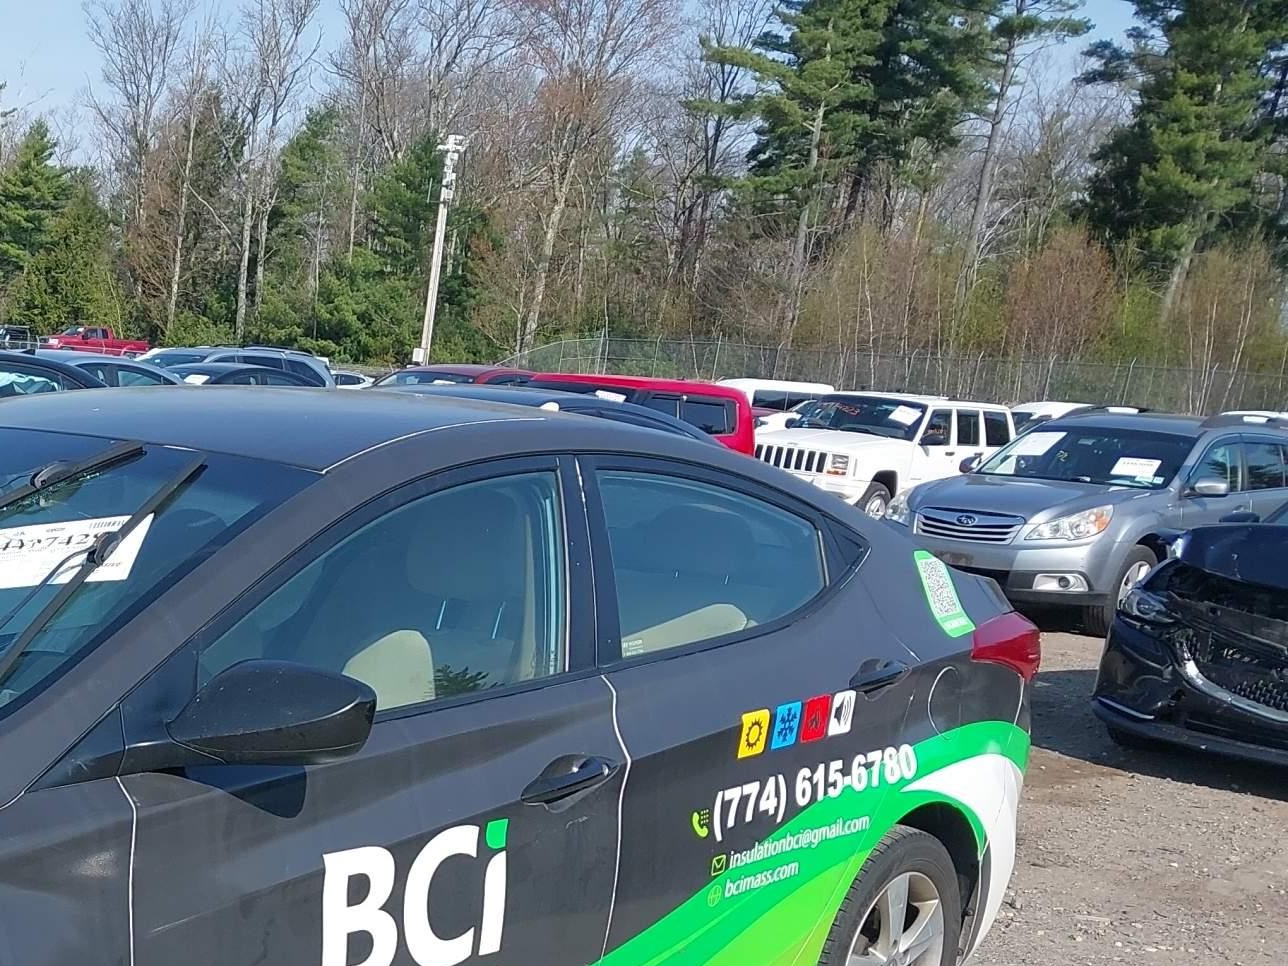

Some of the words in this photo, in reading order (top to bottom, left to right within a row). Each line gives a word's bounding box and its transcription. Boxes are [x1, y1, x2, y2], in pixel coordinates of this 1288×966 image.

[713, 774, 788, 842] (774)
[795, 744, 918, 807] 615-6780
[729, 815, 870, 869] insulationbci@gmail.com
[724, 862, 799, 898] bcimass.com
